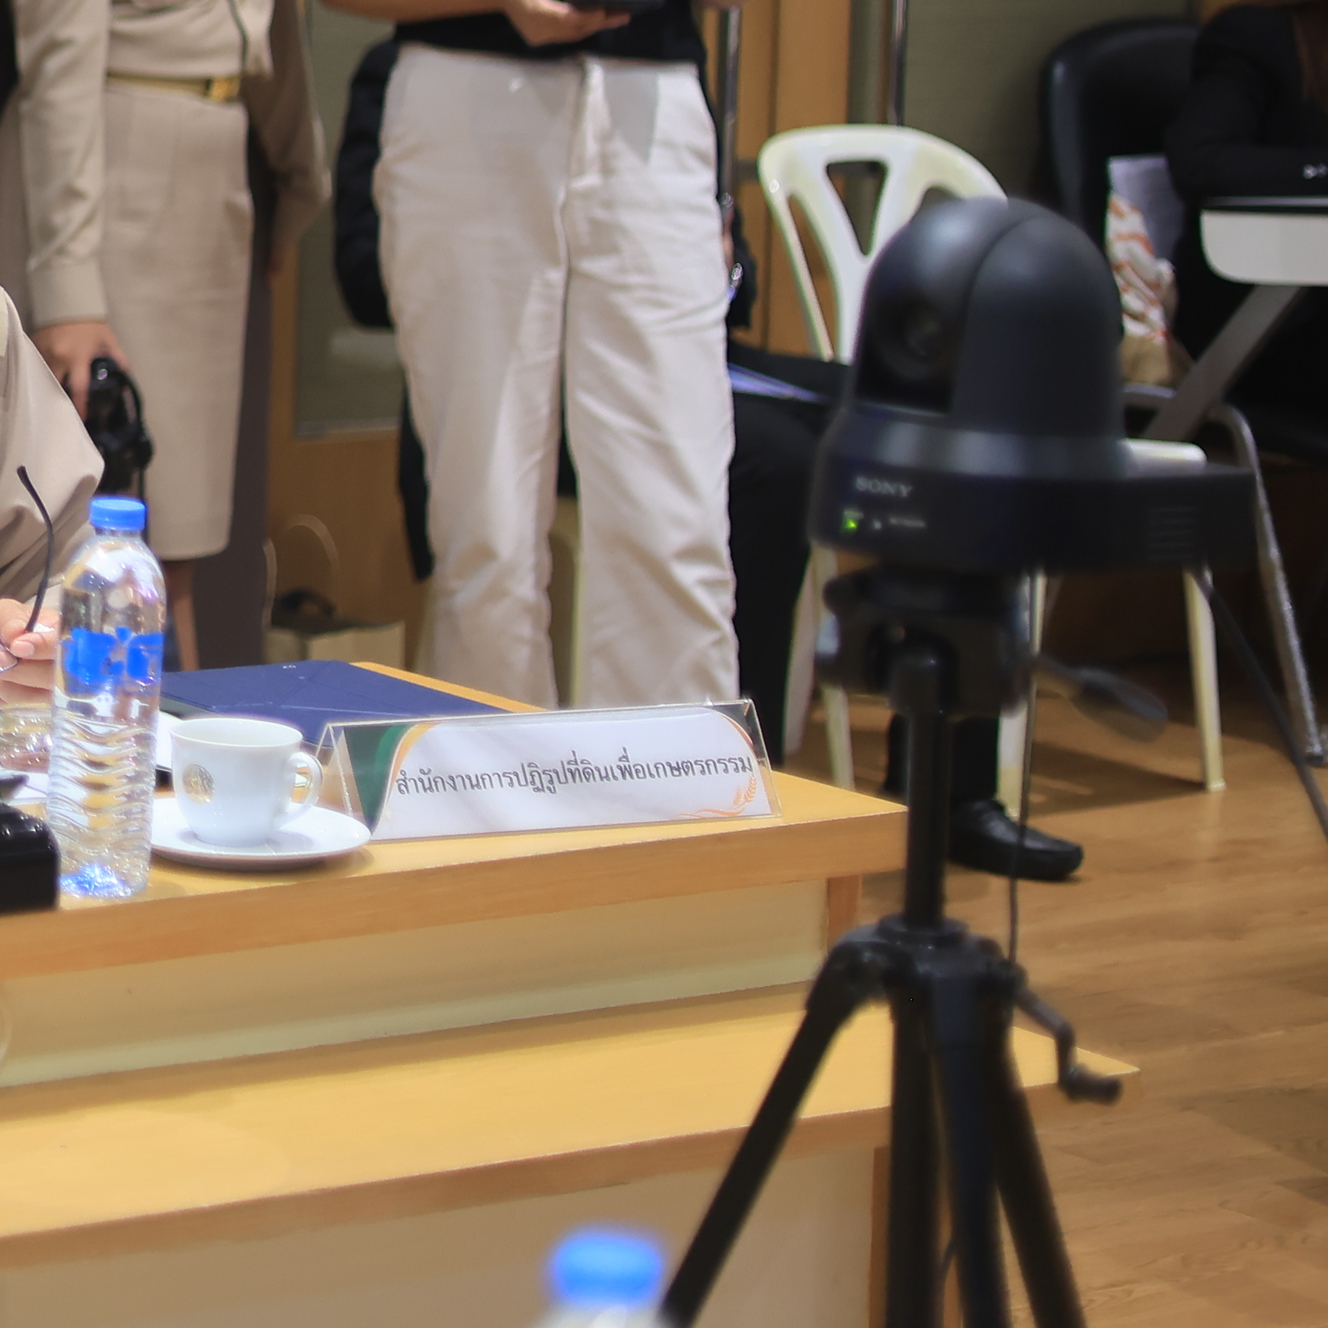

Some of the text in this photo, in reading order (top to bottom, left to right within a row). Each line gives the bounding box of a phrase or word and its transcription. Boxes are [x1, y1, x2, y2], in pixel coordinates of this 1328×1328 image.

[855, 476, 912, 497] SONY
[395, 747, 754, 795] สำนักงานการปฏิรูปที่ดินเพื่อเกษตรกรรม
